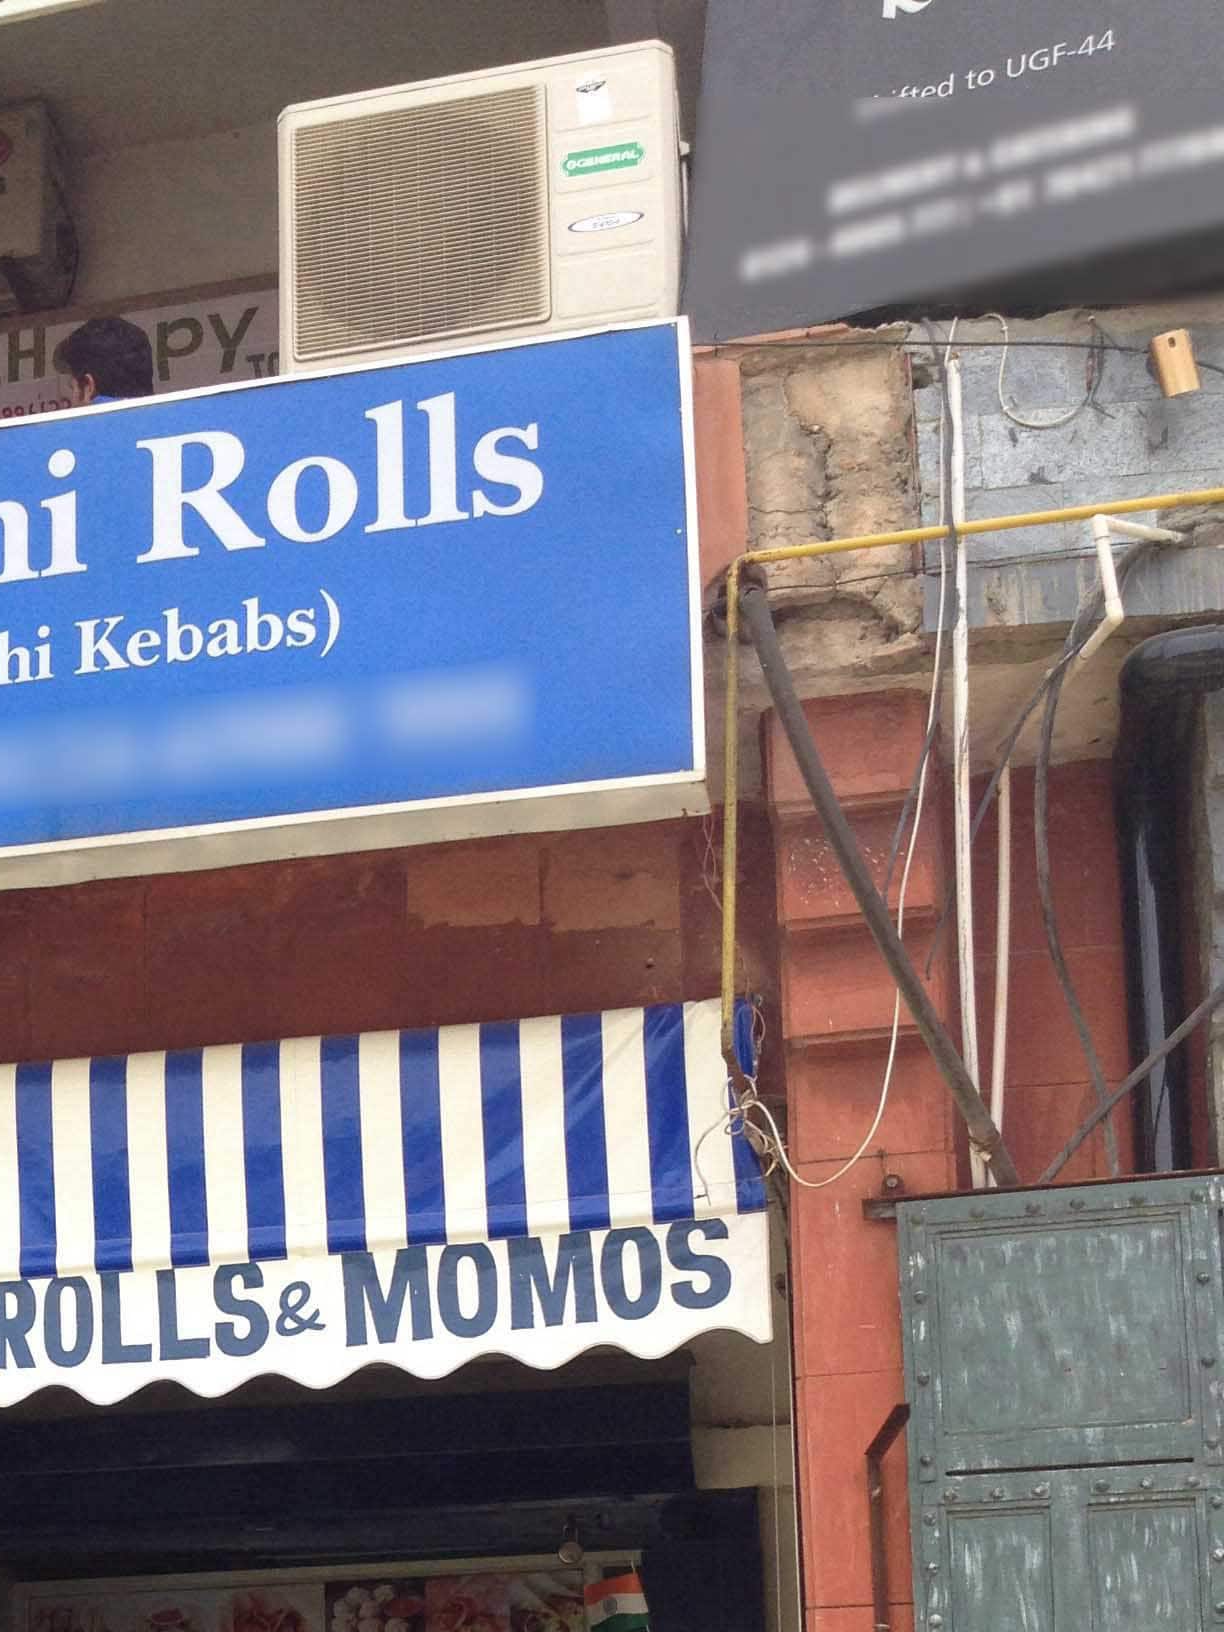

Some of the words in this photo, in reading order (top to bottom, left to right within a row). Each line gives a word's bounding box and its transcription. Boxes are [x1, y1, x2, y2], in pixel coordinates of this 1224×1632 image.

[964, 69, 996, 89] to
[1006, 29, 1117, 79] UGF-44
[135, 390, 545, 565] Rolls
[74, 588, 342, 676] Kebabs)
[275, 1279, 327, 1337] &
[340, 1217, 733, 1349] MOMOS
